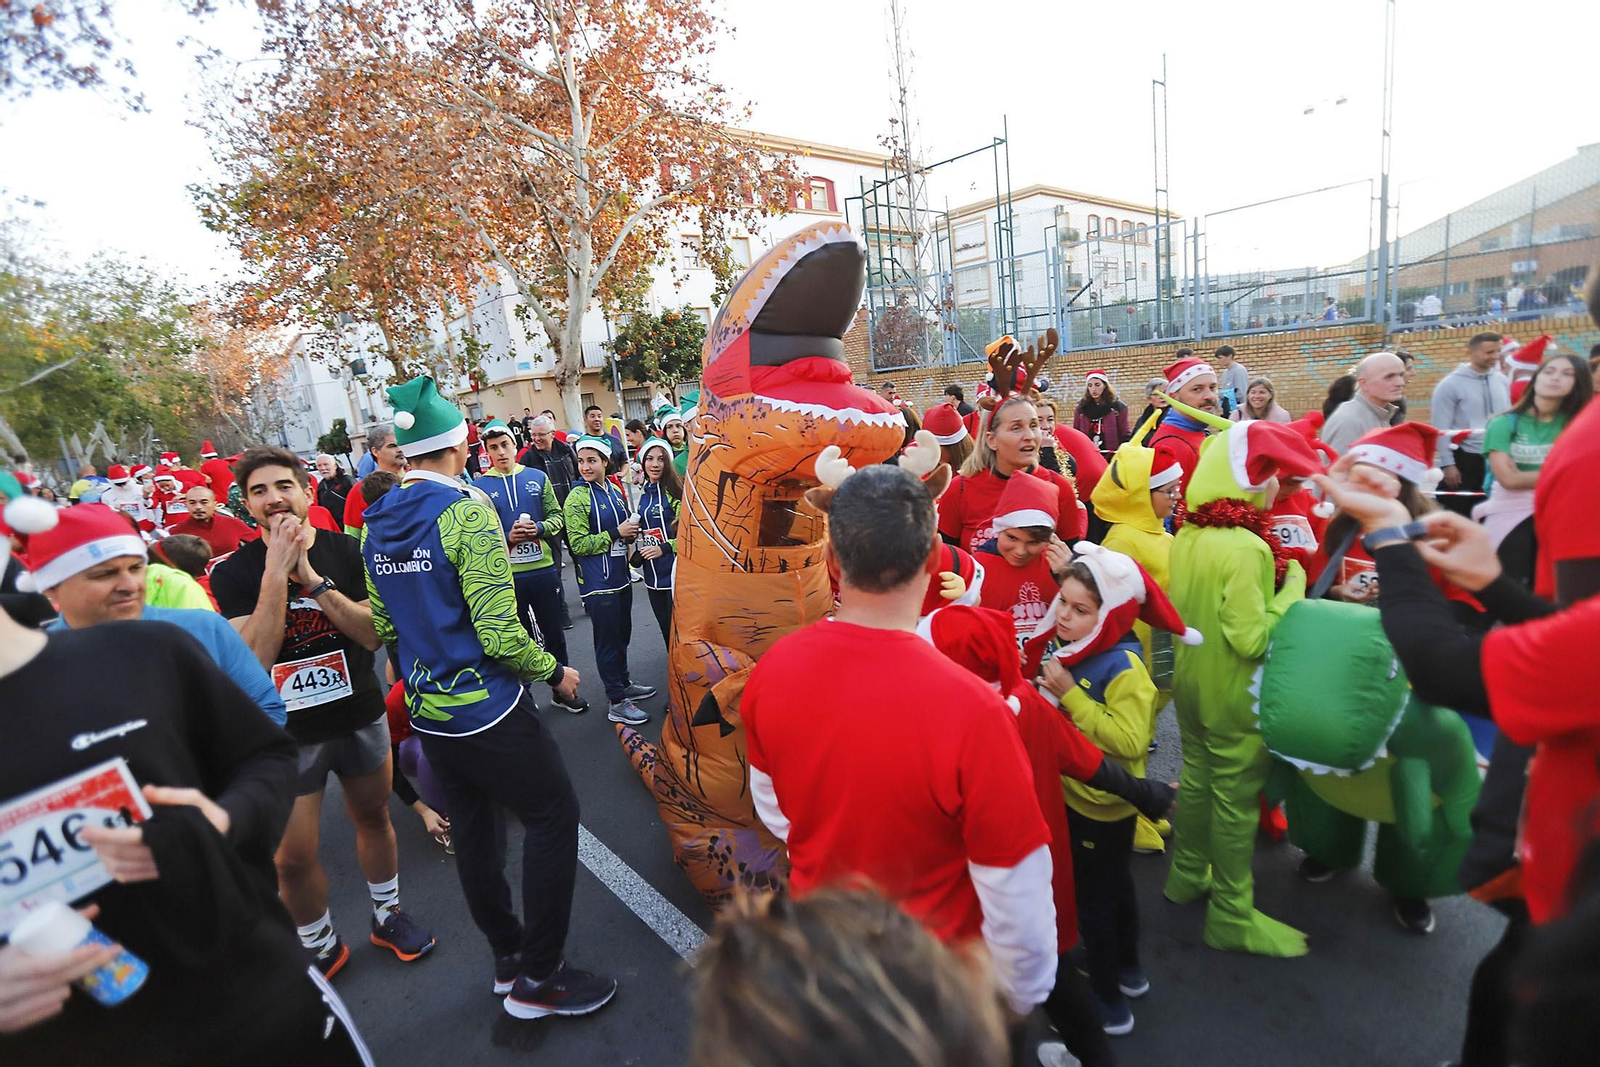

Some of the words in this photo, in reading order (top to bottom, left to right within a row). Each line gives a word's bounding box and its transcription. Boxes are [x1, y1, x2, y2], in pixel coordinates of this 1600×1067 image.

[517, 542, 535, 555] 551
[292, 668, 330, 692] 443
[0, 813, 92, 886] 546
